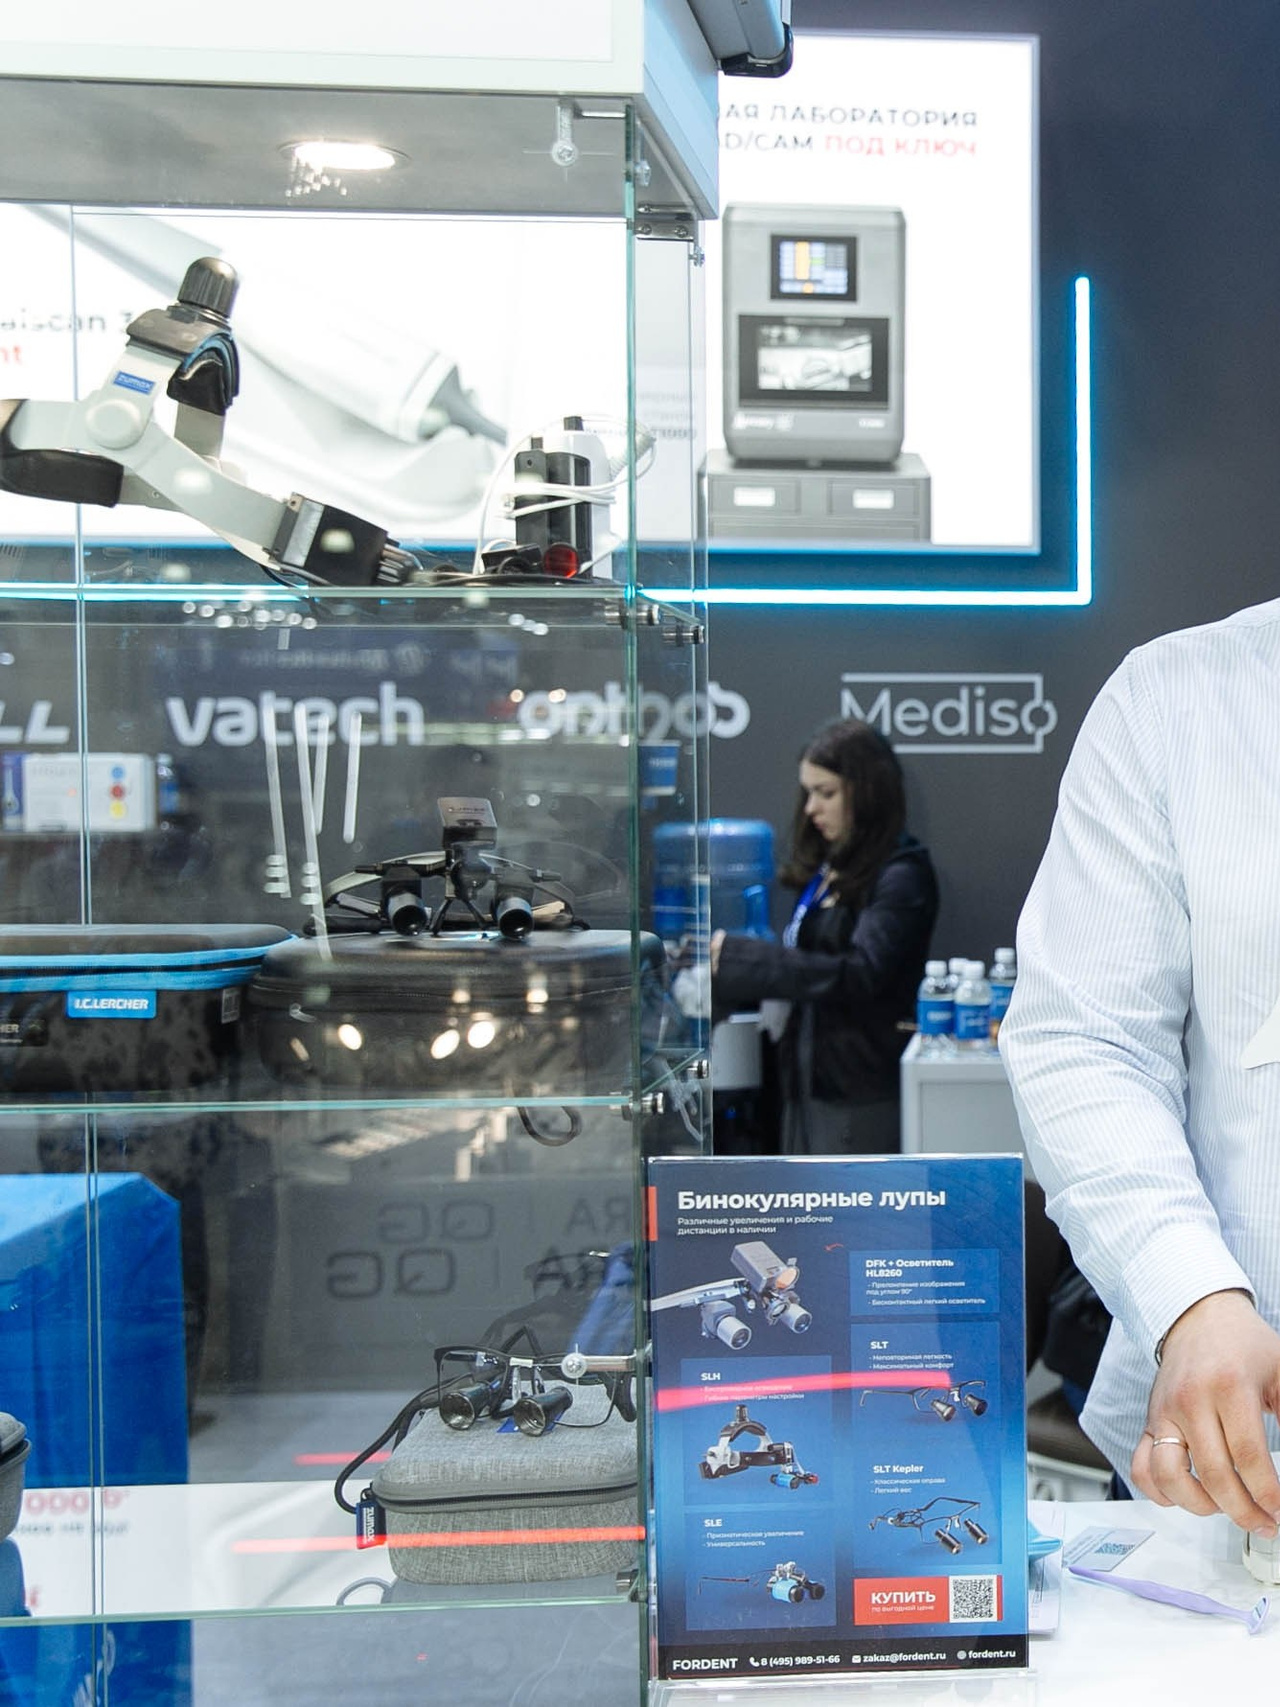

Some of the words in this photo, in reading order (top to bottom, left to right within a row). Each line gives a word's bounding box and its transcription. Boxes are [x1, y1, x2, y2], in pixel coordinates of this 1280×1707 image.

[725, 104, 759, 119] АЯ
[771, 104, 978, 127] ЛАБОРАТОРИЯ
[724, 132, 814, 151] D/CAM
[825, 135, 885, 156] ПОД
[895, 137, 977, 157] КЛЮЧ
[166, 682, 425, 747] vatech
[840, 685, 1058, 738] Mediso
[677, 1189, 873, 1213] Бинокулярные
[879, 1189, 946, 1211] лупы
[677, 1217, 729, 1227] Различные
[730, 1216, 785, 1226] увеличения
[786, 1216, 793, 1224] и
[794, 1214, 834, 1225] рабочие
[677, 1225, 728, 1236] дистанции
[729, 1226, 735, 1235] в
[736, 1224, 777, 1235] наличии
[866, 1259, 887, 1269] DFK
[896, 1258, 955, 1268] Осветитель
[866, 1268, 903, 1278] HL8260
[919, 1280, 966, 1289] изображения
[872, 1297, 923, 1307] Бесконтактный
[948, 1297, 987, 1305] осветитель
[870, 1340, 889, 1350] SLT
[923, 1353, 953, 1361] легкость
[925, 1361, 954, 1370] комфорт
[701, 1372, 721, 1381] SLH
[873, 1464, 891, 1474] SLT
[892, 1463, 925, 1475] Kepler
[703, 1518, 723, 1528] SLE
[705, 1540, 767, 1549] Универсальность
[870, 1590, 937, 1605] КУПИТЬ
[672, 1657, 739, 1671] FORDENT
[760, 1657, 768, 1667] 8
[769, 1656, 794, 1668] (495)
[794, 1654, 841, 1666] 989-51-66
[862, 1651, 947, 1664] zakaz@fordent.ru
[968, 1649, 1017, 1660] fordent.ru
